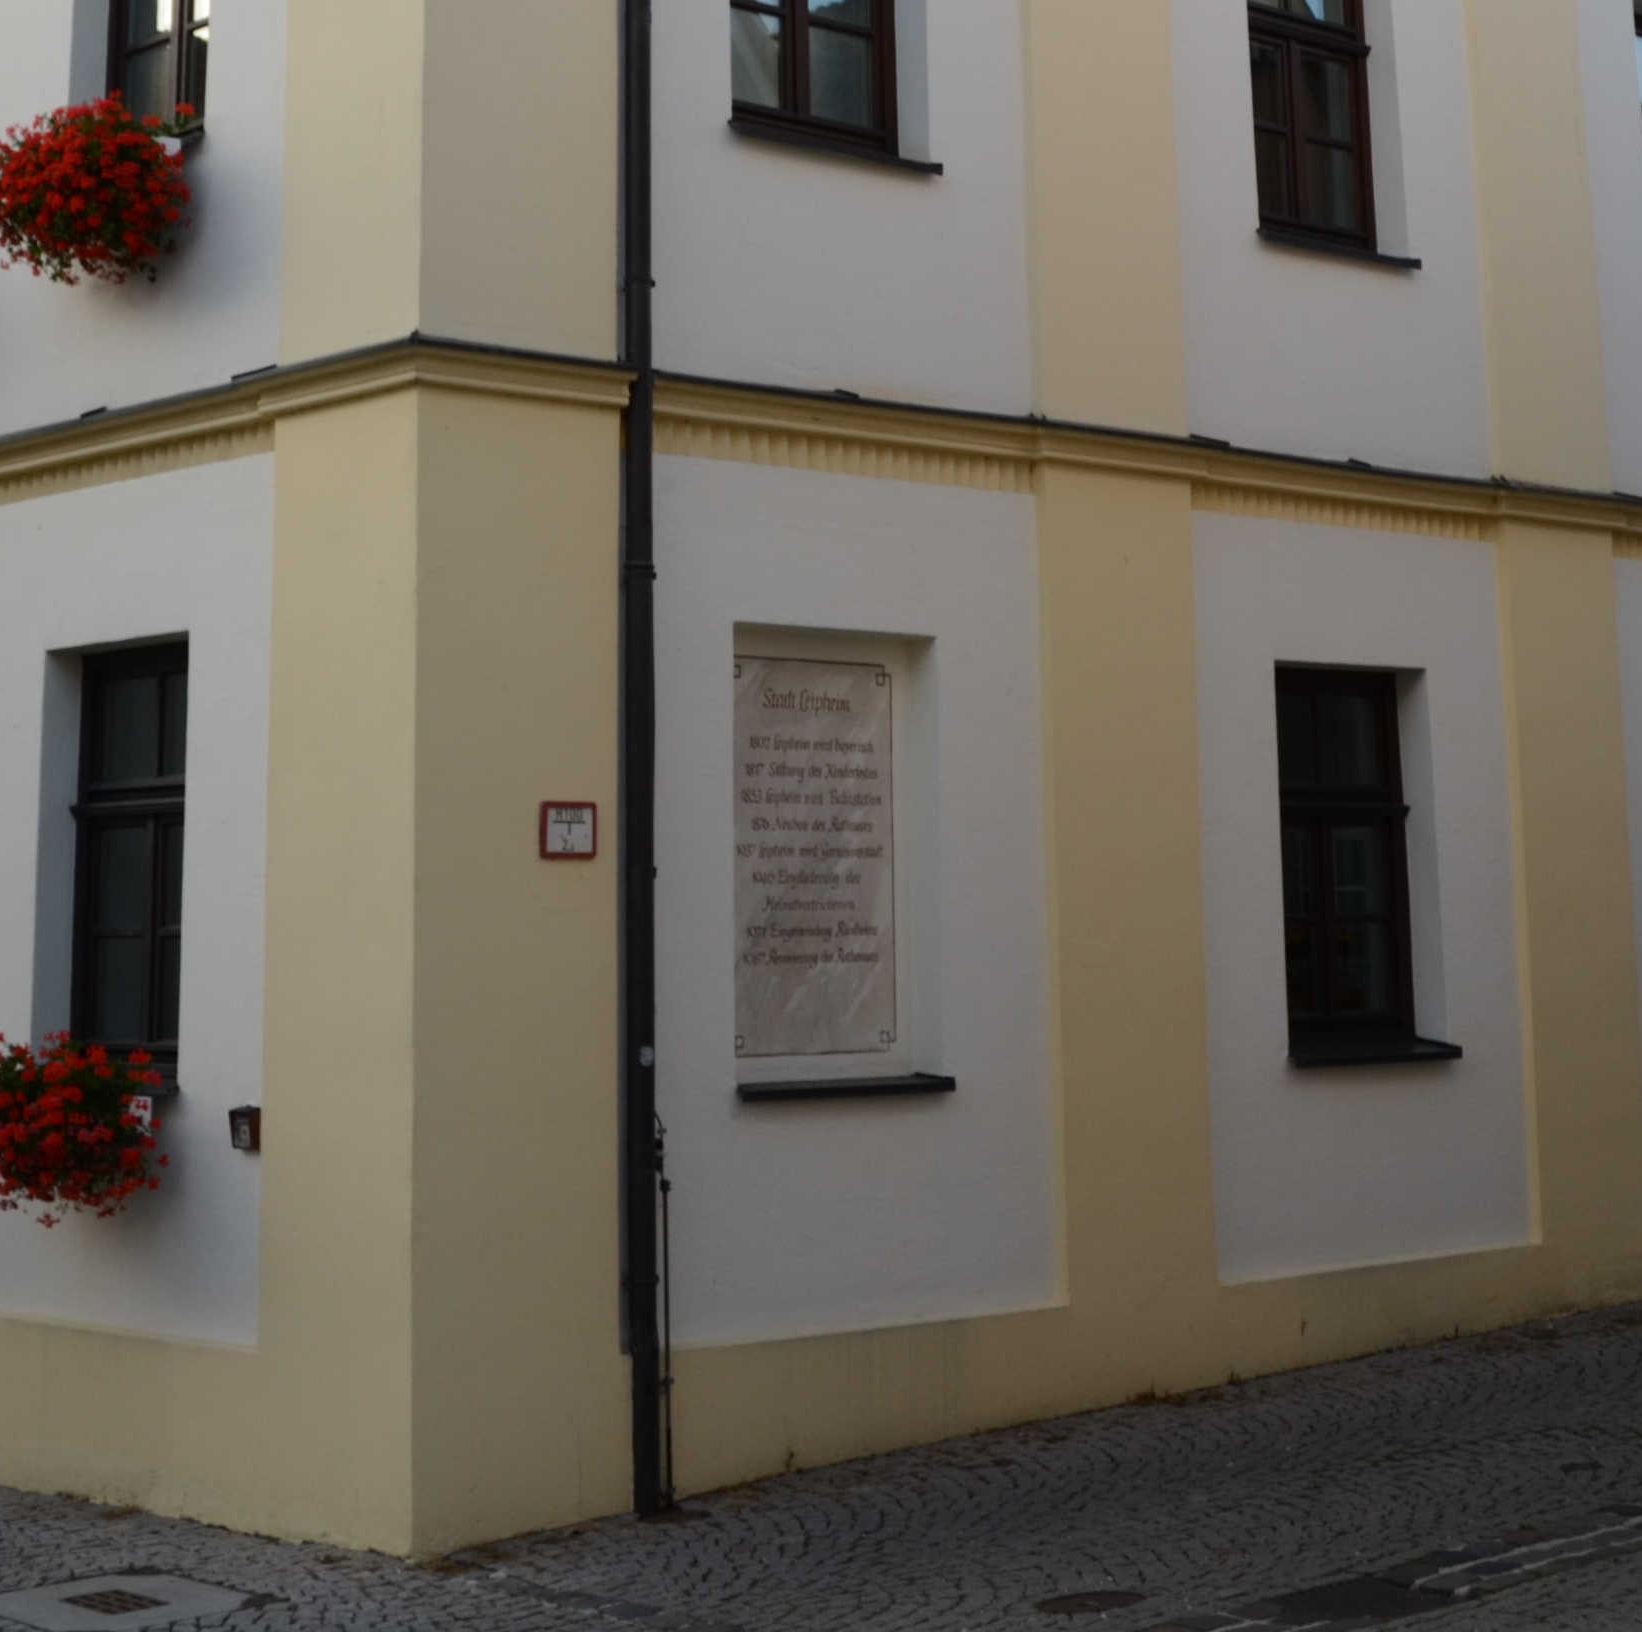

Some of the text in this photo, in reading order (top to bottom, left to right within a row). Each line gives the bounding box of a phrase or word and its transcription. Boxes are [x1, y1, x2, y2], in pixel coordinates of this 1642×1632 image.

[762, 687, 851, 716] Stadt Leipheim
[773, 733, 810, 755] Leipheim
[812, 738, 833, 752] wird
[834, 737, 874, 755] bayerisch
[767, 761, 805, 784] Stiftung
[807, 764, 823, 779] des
[765, 787, 801, 808] Leipheim
[804, 791, 823, 805] wird
[771, 816, 809, 832] Neubau
[811, 818, 827, 832] des
[758, 842, 795, 862] Leipheim
[799, 844, 819, 858] wird
[777, 868, 840, 890] Eingliederung
[845, 870, 862, 885] der
